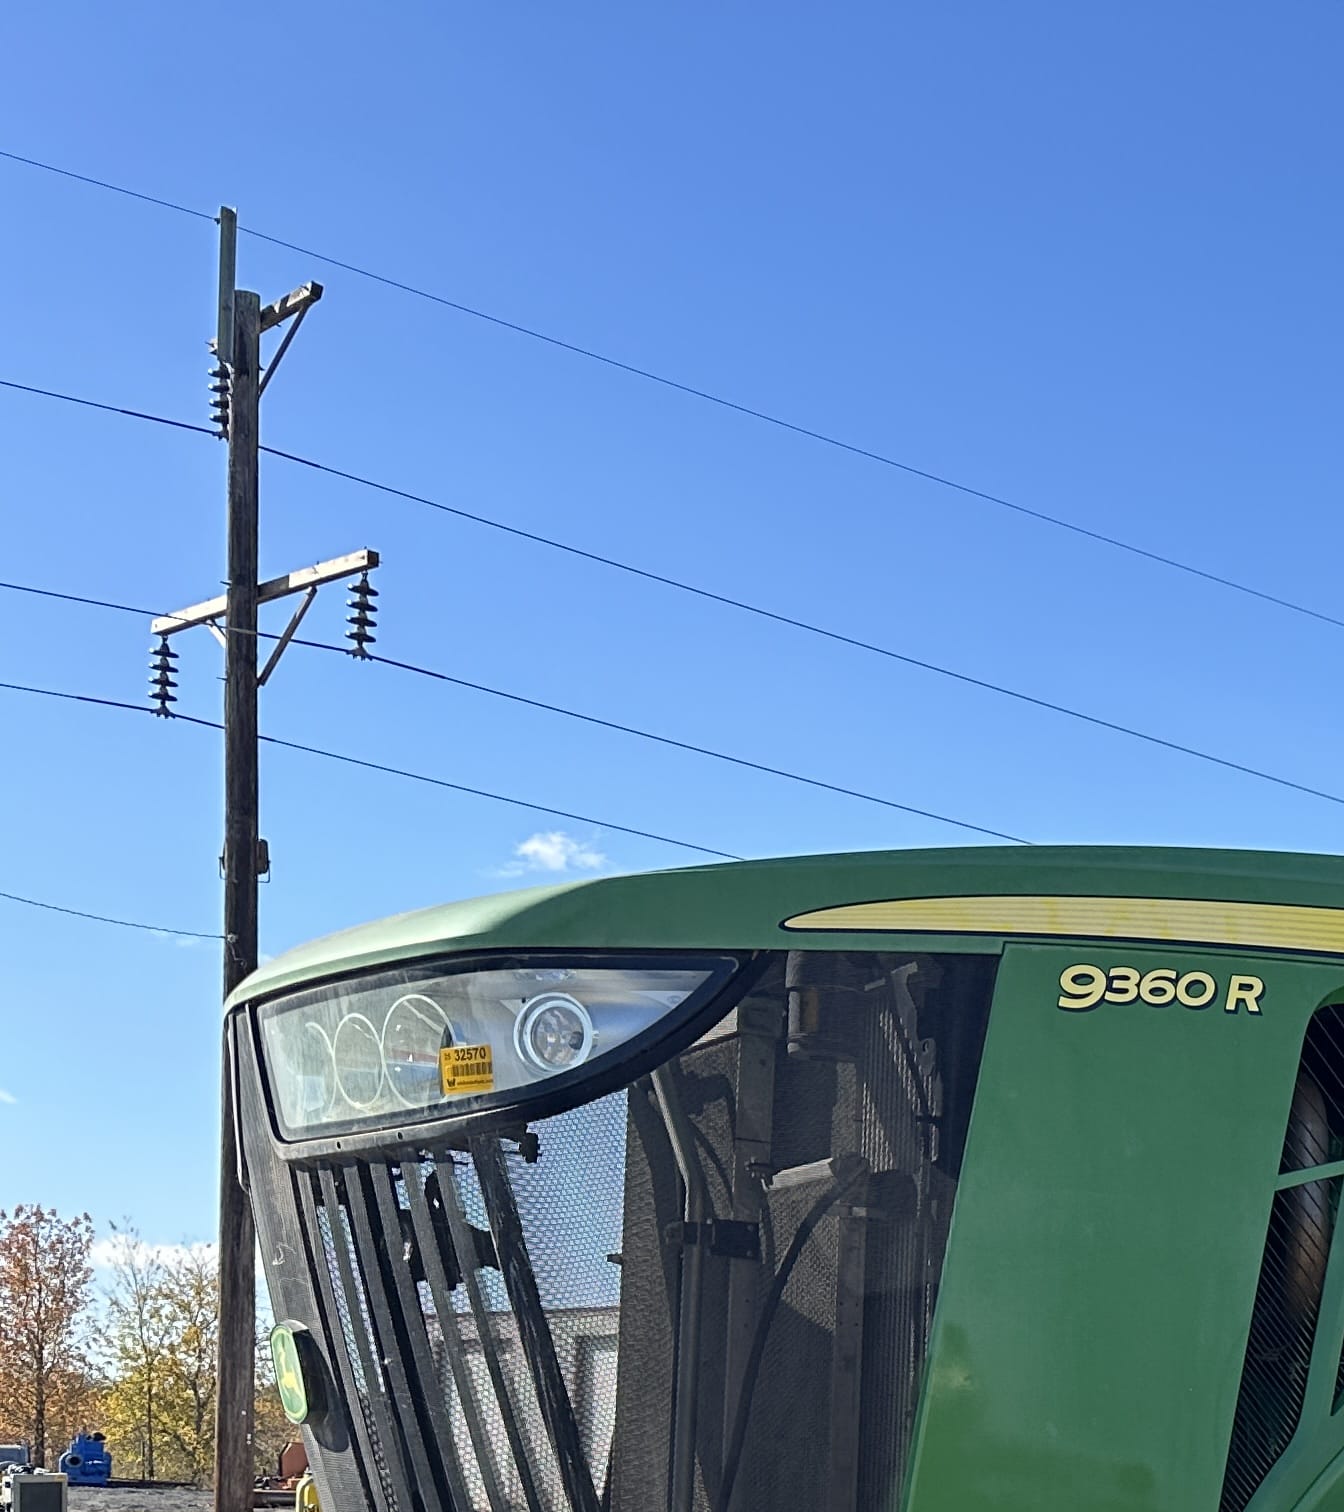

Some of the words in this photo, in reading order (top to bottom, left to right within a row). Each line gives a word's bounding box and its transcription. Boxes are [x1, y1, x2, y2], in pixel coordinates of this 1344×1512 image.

[1057, 963, 1216, 1011] 9360
[1223, 974, 1264, 1015] R
[454, 1047, 486, 1061] 32570
